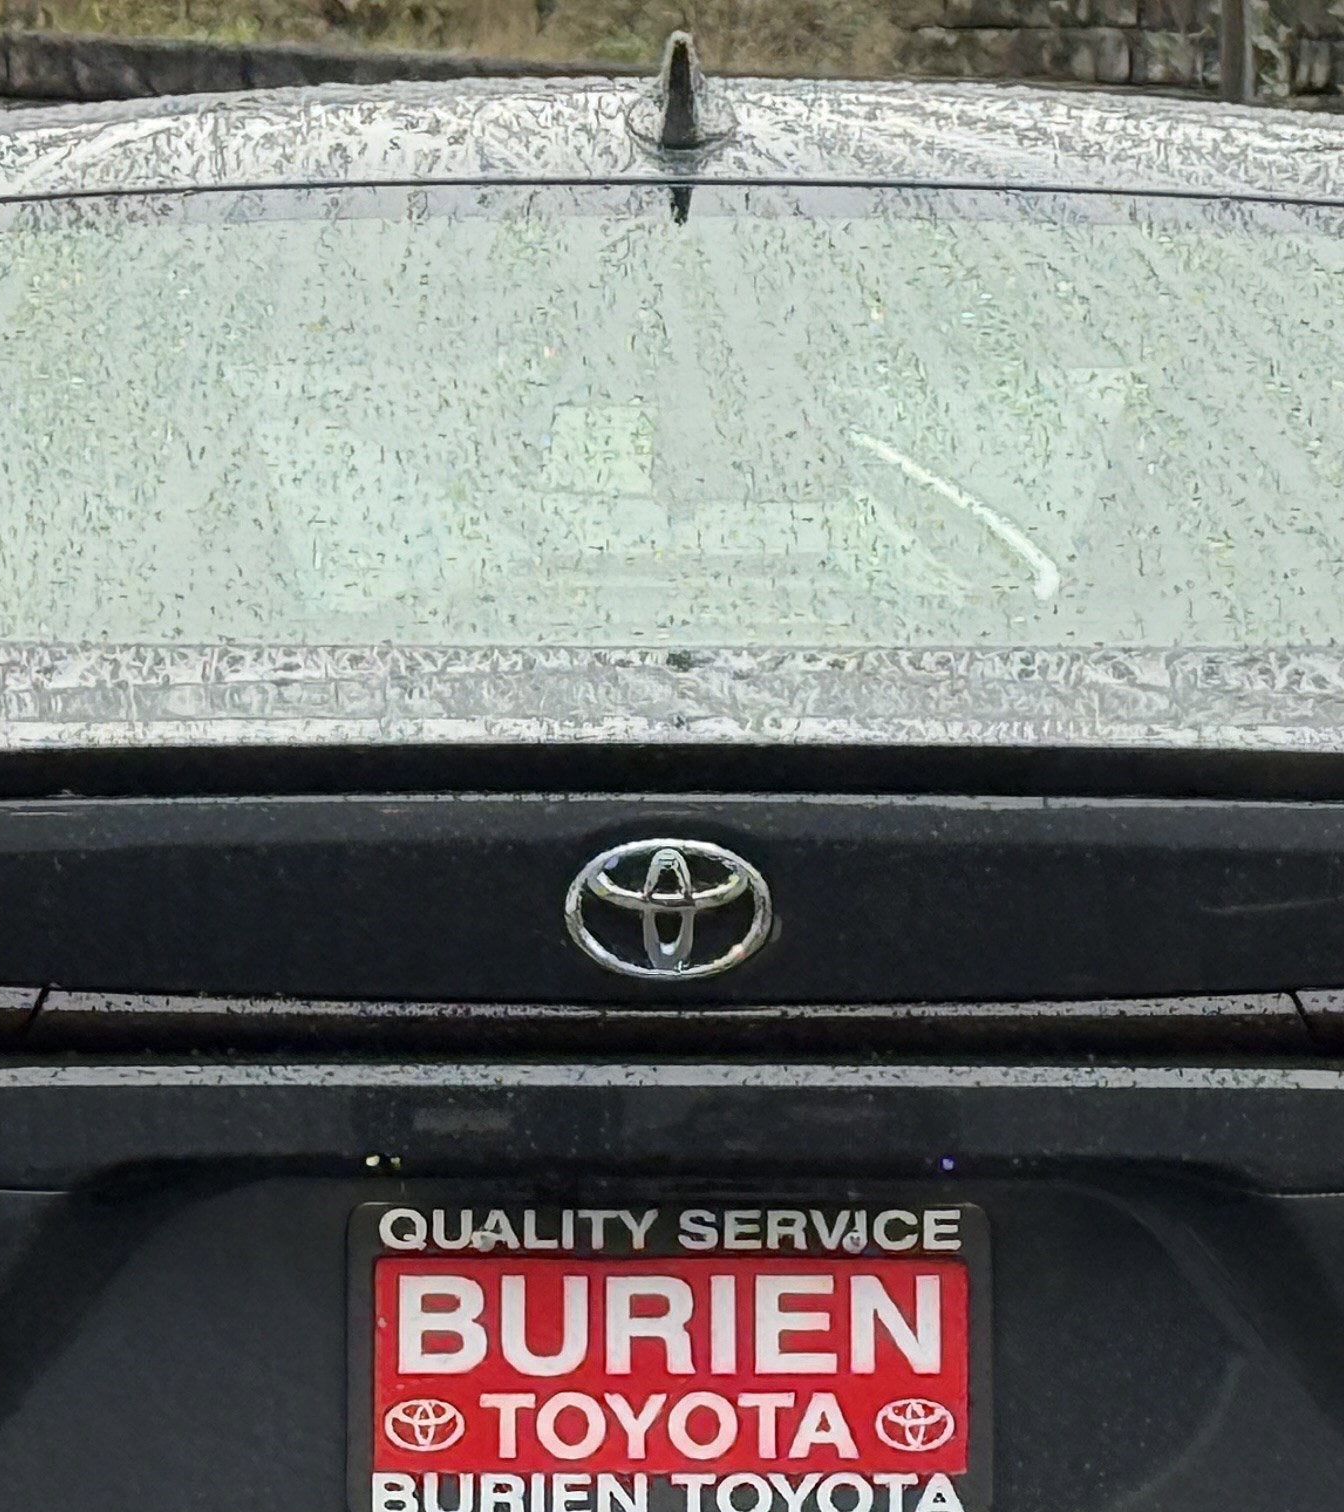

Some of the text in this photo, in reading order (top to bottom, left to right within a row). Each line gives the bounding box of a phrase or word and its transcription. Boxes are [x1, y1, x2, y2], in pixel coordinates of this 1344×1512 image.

[378, 1208, 962, 1251] QUALITY SERVICE
[397, 1274, 942, 1376] BURIEN
[479, 1391, 860, 1460] TOYOTA
